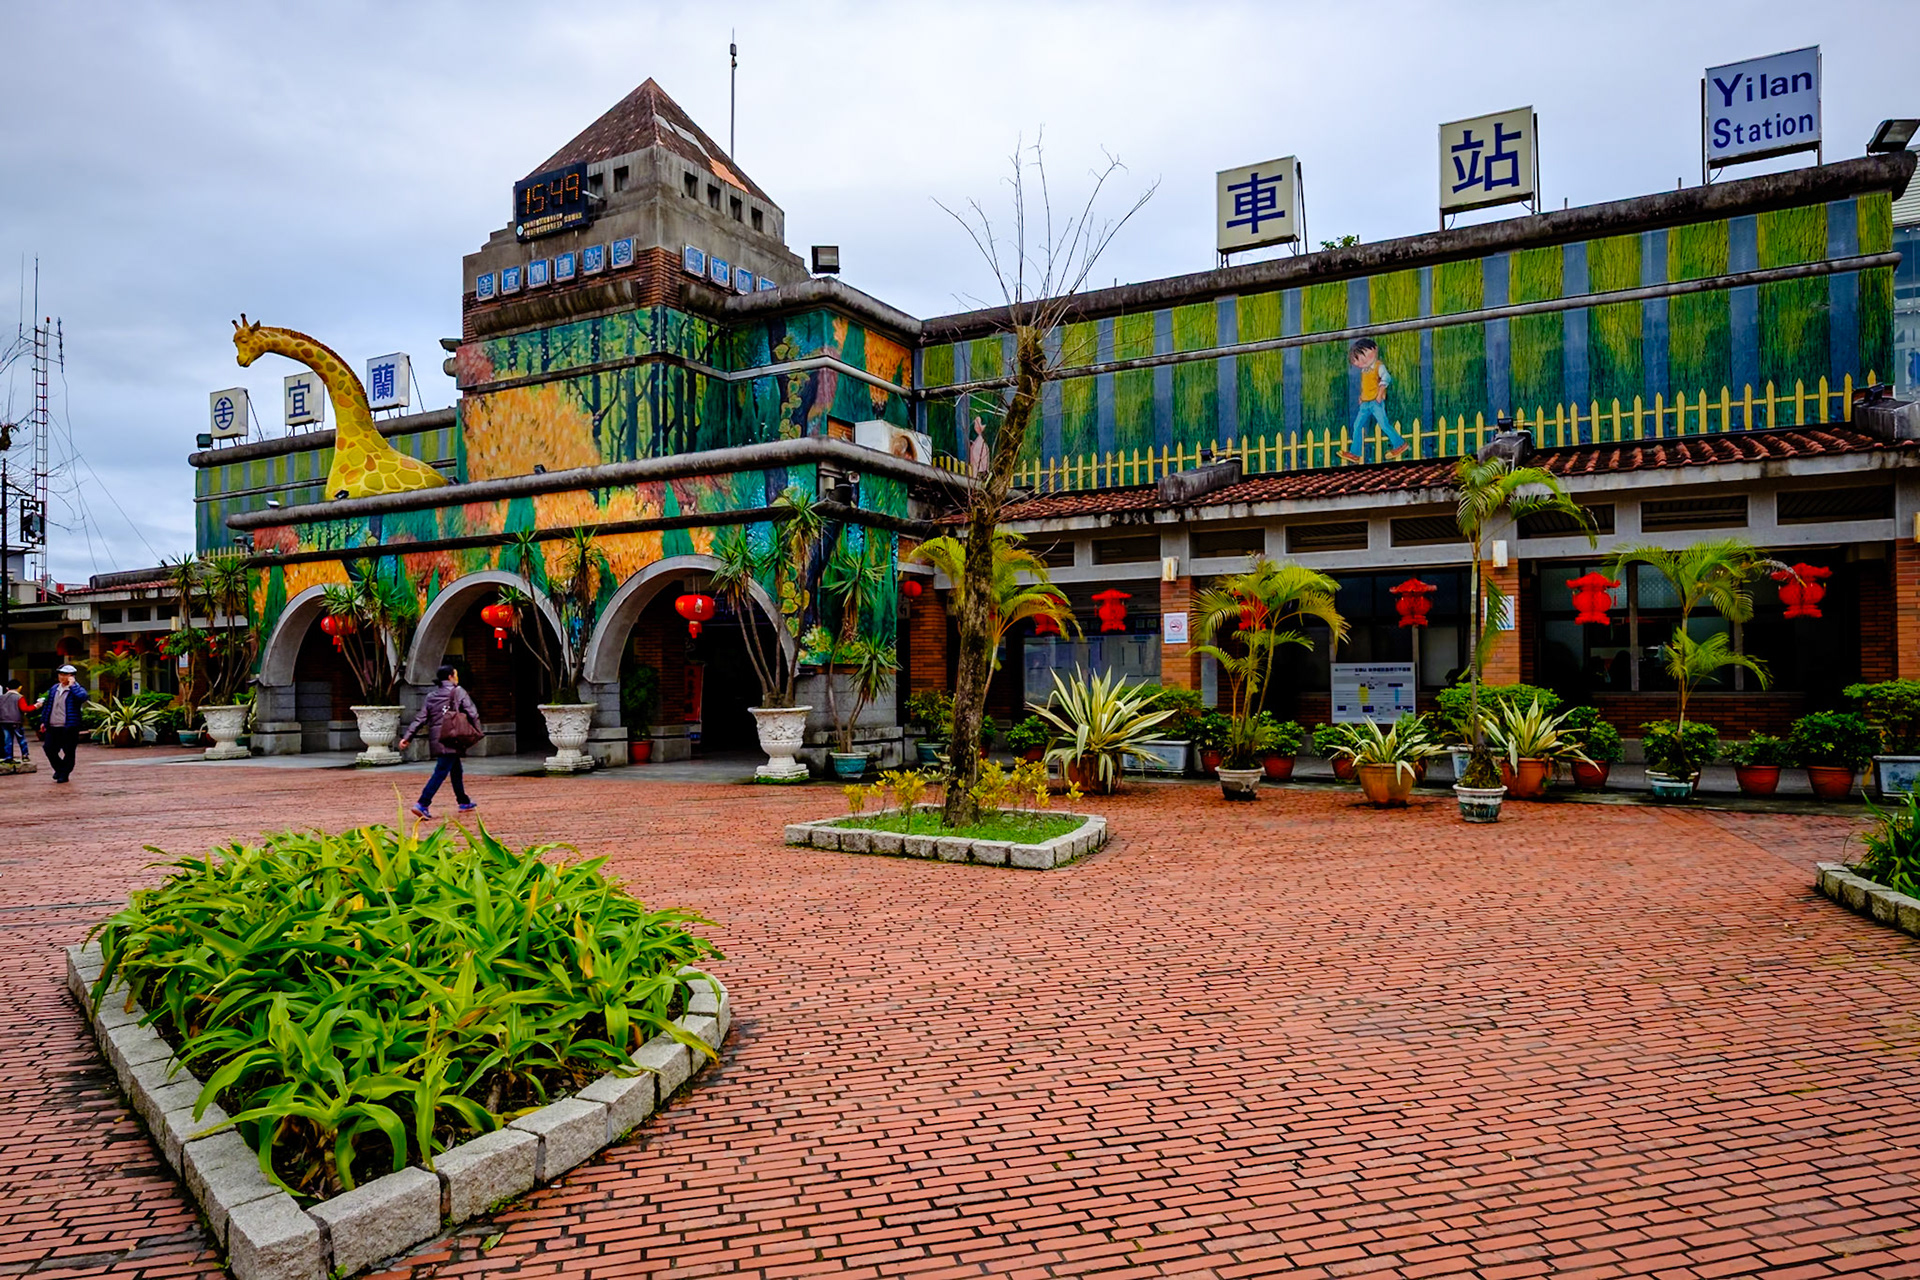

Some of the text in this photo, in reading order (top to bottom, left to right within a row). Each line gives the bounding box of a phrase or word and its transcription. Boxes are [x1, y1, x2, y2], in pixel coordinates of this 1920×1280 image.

[1712, 72, 1812, 107] Yilan
[1712, 113, 1813, 149] Station
[526, 173, 580, 215] 15:49
[1226, 122, 1522, 234] 車 站
[288, 363, 396, 419] 宜 蘭
